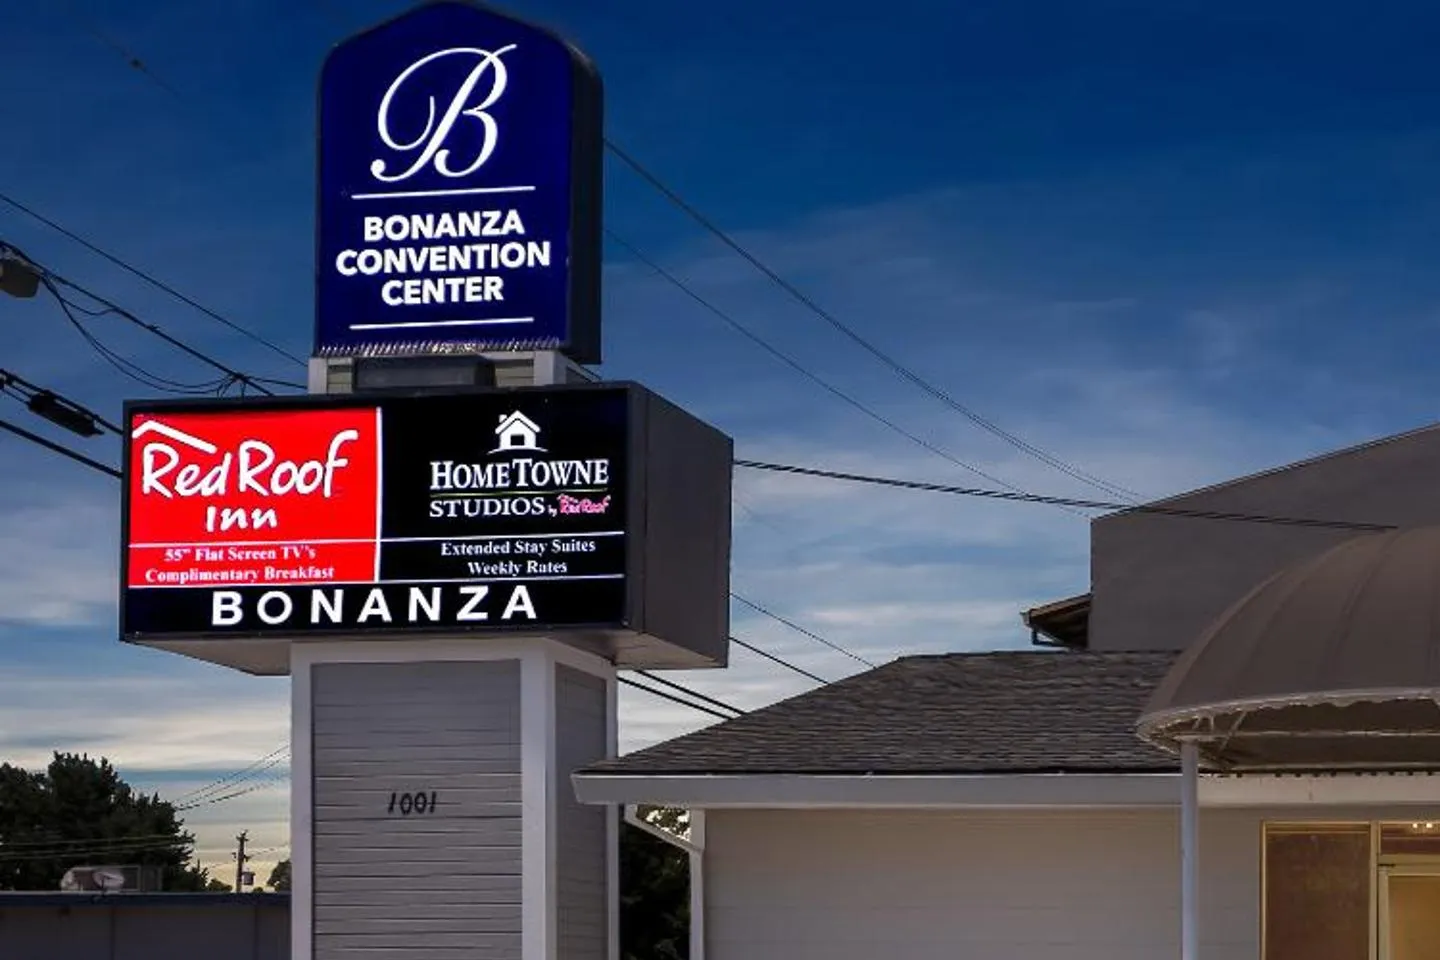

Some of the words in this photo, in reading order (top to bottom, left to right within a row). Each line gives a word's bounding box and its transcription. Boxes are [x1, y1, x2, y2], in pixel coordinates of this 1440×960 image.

[370, 43, 517, 182] B
[363, 209, 525, 242] BONANZA
[335, 241, 551, 276] CONVENTION
[381, 276, 504, 306] CENTER
[429, 497, 545, 518] STUDIOS
[195, 548, 224, 562] Flat
[228, 546, 276, 561] Screen
[440, 541, 510, 556] Extended
[514, 540, 548, 557] Stay
[552, 539, 596, 553] Suites
[145, 568, 259, 584] Complimentary
[264, 566, 335, 580] Breakfast
[468, 561, 522, 577] Weekly
[527, 559, 568, 574] Rates
[212, 585, 537, 626] BONANZA
[388, 791, 437, 815] 1001
